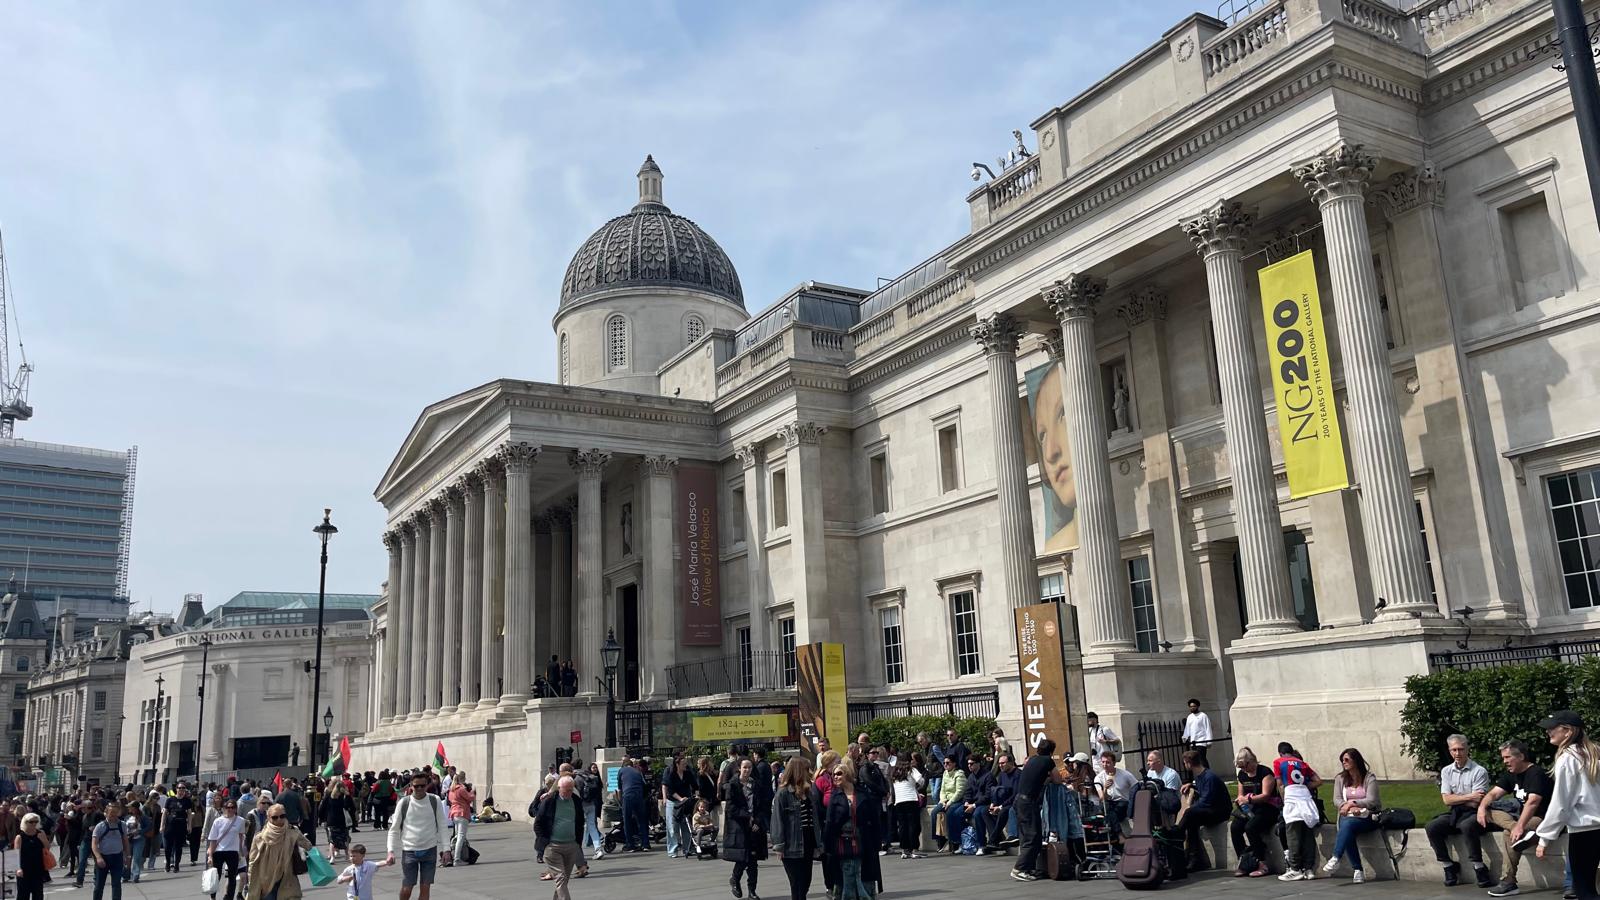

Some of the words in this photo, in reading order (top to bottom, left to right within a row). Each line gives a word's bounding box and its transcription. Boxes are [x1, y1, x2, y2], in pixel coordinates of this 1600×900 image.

[1302, 293, 1313, 326] GALLERY
[1308, 327, 1319, 366] NATIONAL
[1273, 299, 1318, 446] NG200
[1317, 385, 1324, 396] OF
[1319, 397, 1328, 423] YEARS
[687, 492, 697, 540] Velasco
[701, 508, 711, 550] Mexico
[688, 541, 698, 575] María
[701, 552, 713, 566] of
[689, 578, 700, 606] José
[702, 570, 713, 596] View
[703, 598, 712, 606] A
[189, 631, 255, 644] NATIONAL
[263, 628, 329, 638] GALLERY
[1024, 612, 1032, 644] PAINTING
[1024, 657, 1047, 749] SIENA
[718, 718, 765, 729] 1824-2024
